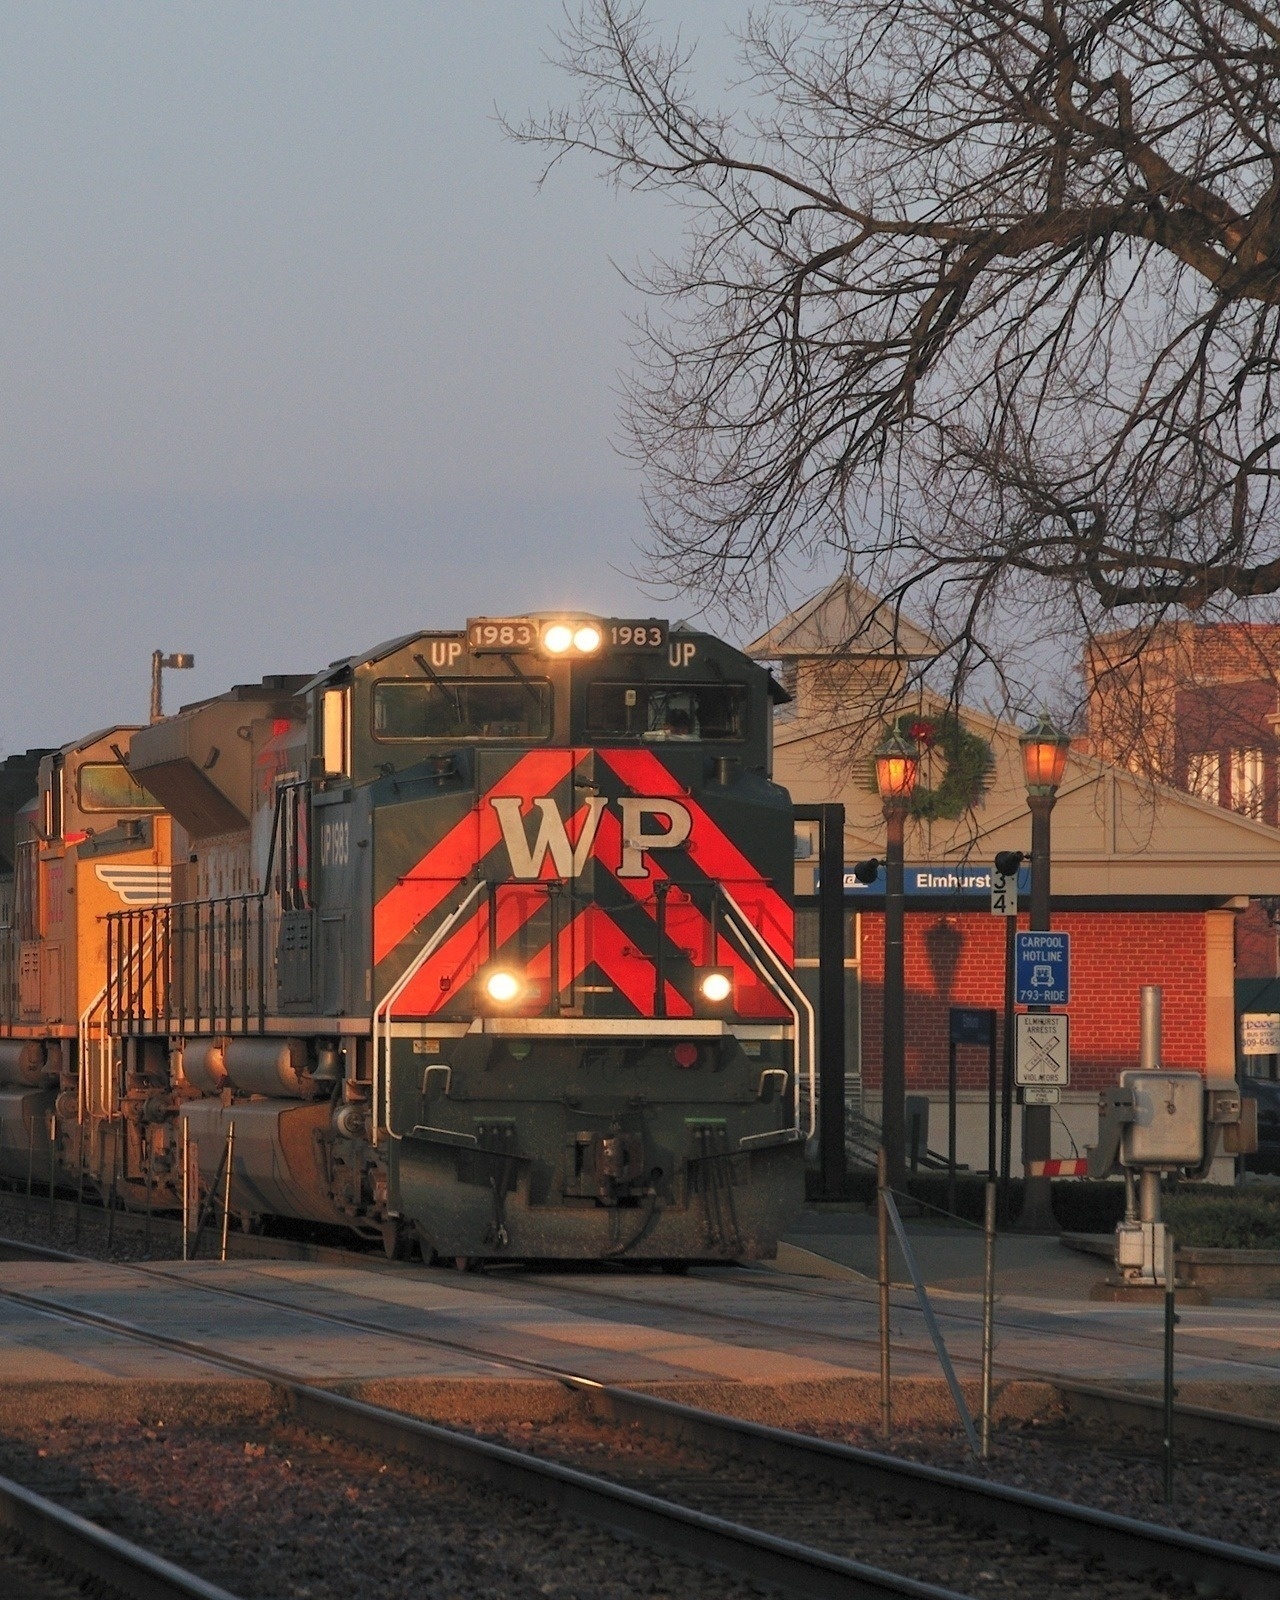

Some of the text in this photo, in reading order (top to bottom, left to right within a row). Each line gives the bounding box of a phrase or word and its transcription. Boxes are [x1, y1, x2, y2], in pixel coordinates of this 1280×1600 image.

[475, 626, 531, 645] 1983
[611, 627, 662, 646] 1983
[431, 642, 462, 667] UP
[669, 643, 696, 667] UP
[490, 797, 692, 878] WP
[916, 874, 991, 888] Elmhurst
[993, 895, 1006, 913] 4
[1021, 936, 1064, 948] CARPOOL
[1022, 950, 1063, 962] HOTLINE
[1020, 990, 1065, 1001] 793-RIDE
[1024, 1018, 1059, 1026] ELMHURST
[1027, 1026, 1057, 1034] ARRESTS
[1023, 1073, 1059, 1082] VIOLATORS
